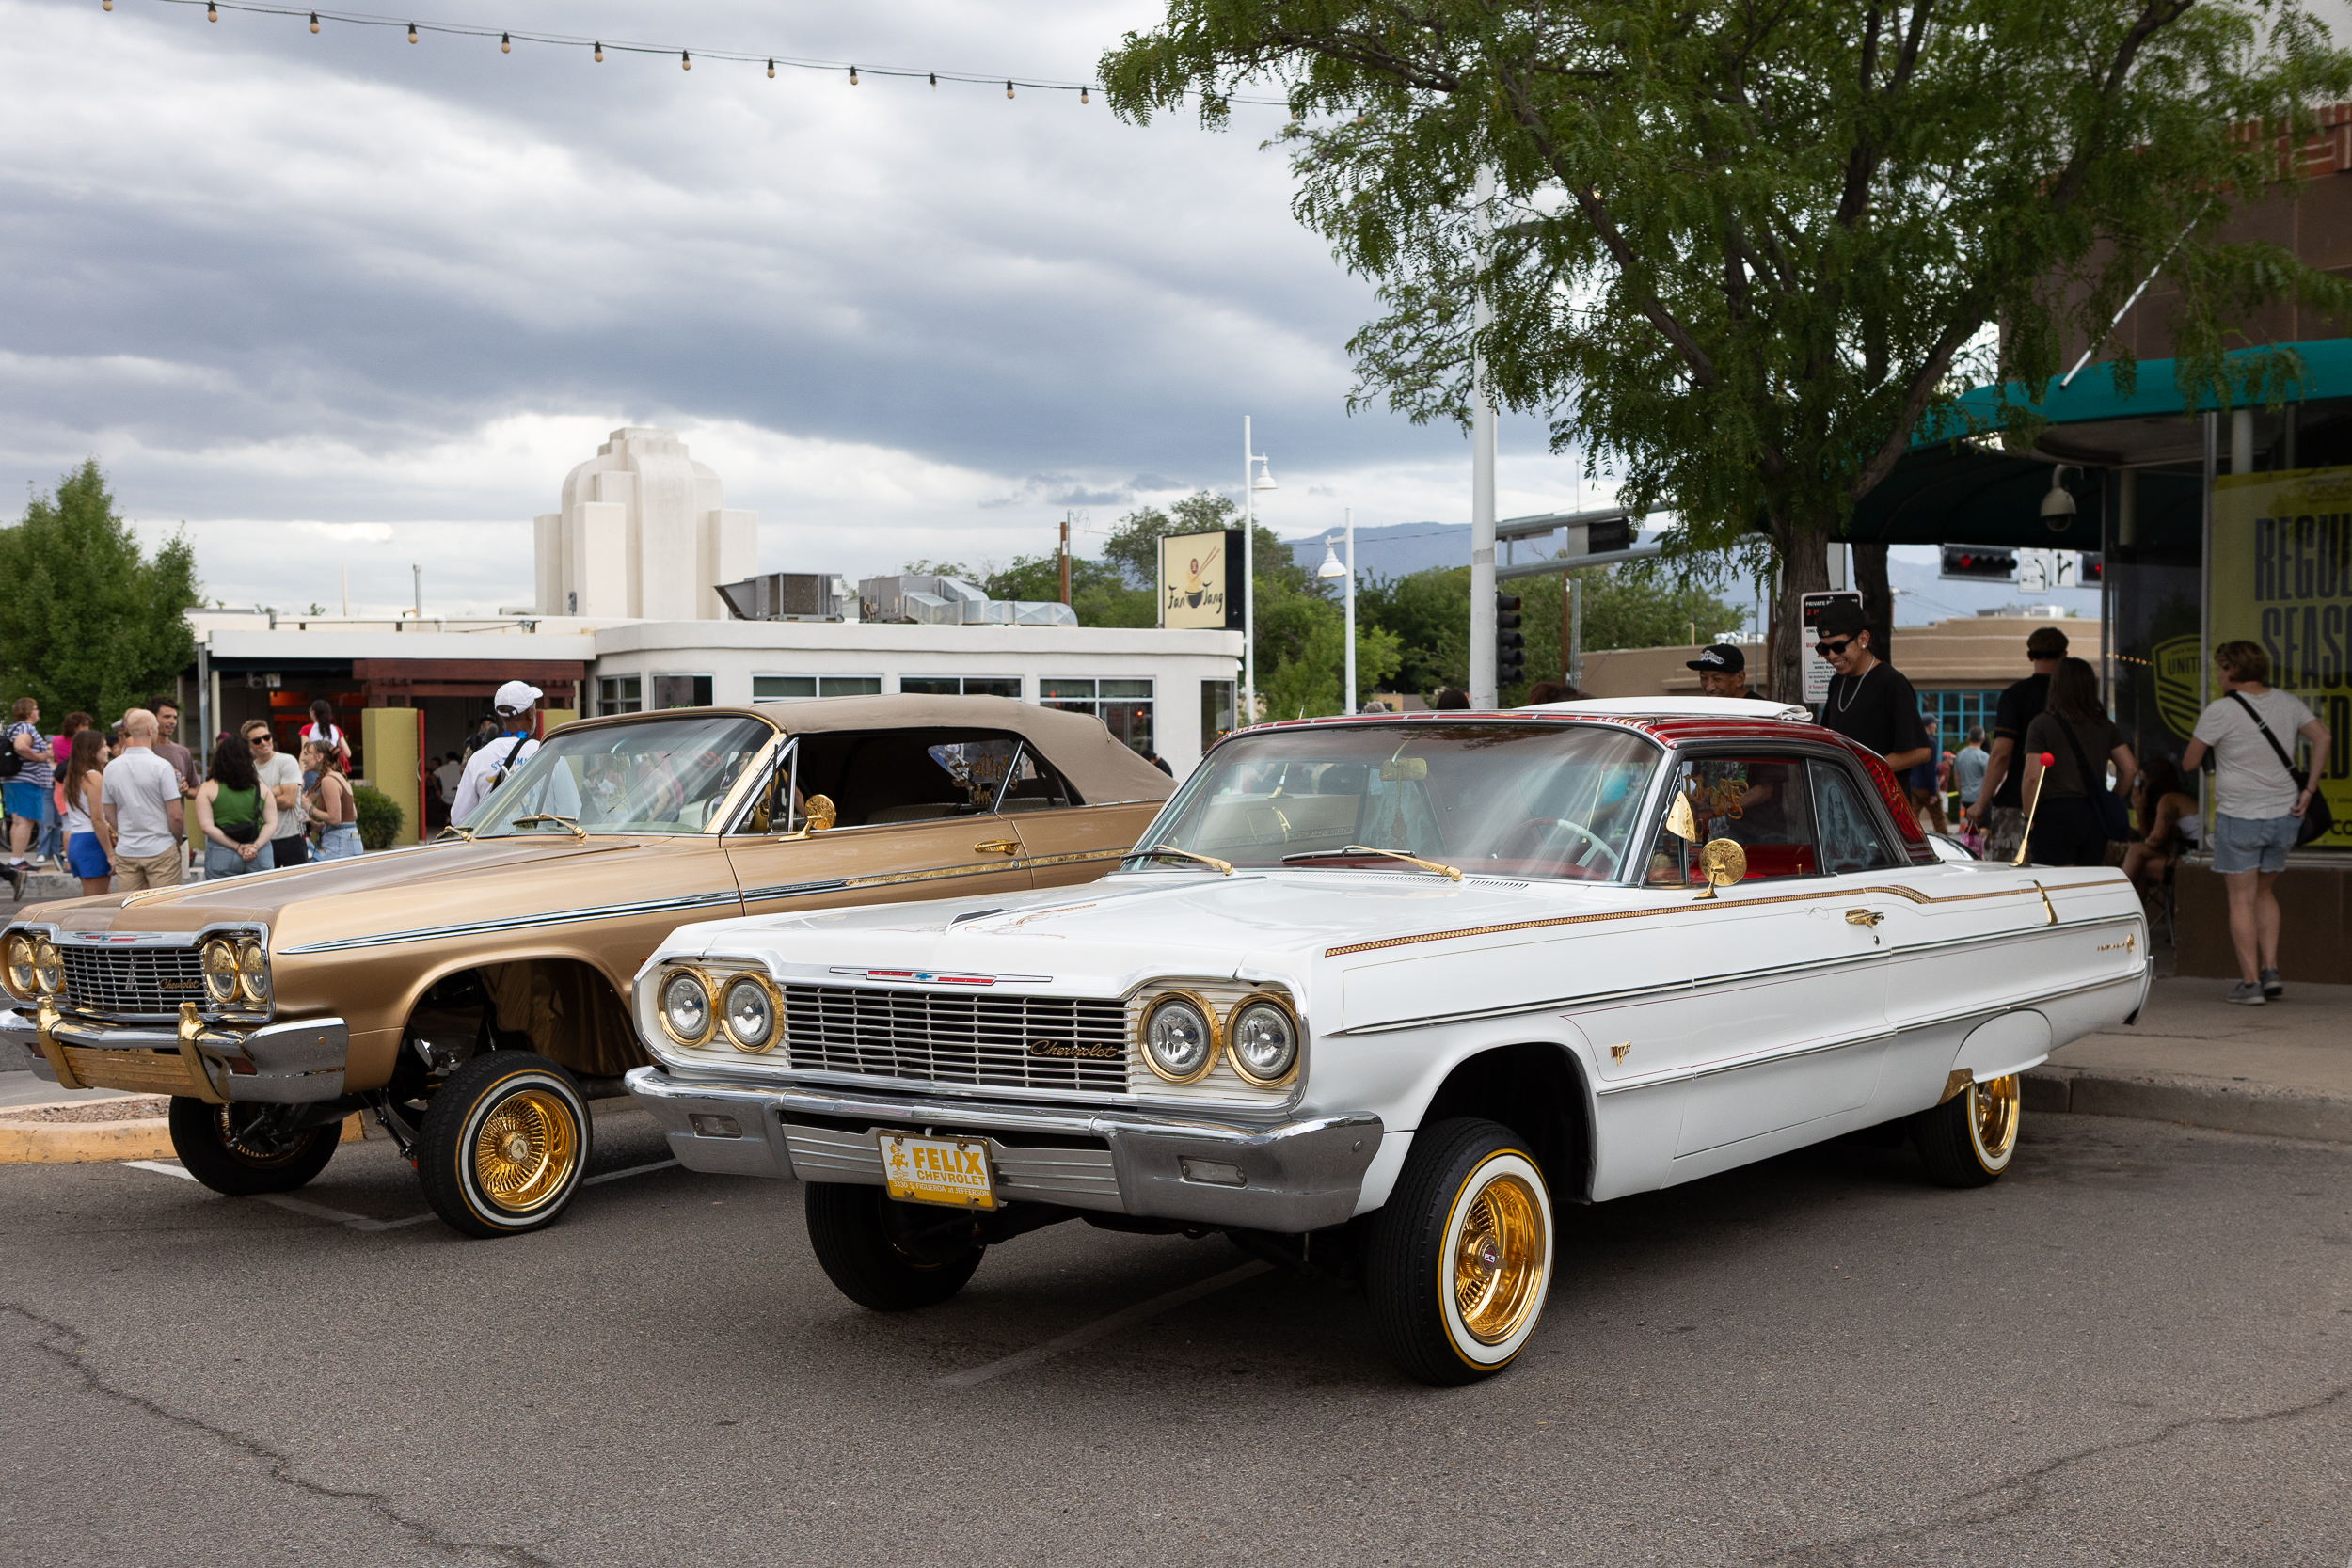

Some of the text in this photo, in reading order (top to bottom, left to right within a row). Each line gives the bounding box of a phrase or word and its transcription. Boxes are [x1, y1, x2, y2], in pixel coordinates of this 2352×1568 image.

[2168, 657, 2201, 674] UNIT
[159, 978, 200, 990] Chevrolet
[1030, 1039, 1118, 1058] Chevrolet
[912, 1147, 985, 1176] FELIX
[916, 1169, 986, 1186] CHEVROLET
[892, 1180, 909, 1189] 3330
[915, 1183, 946, 1193] FIGUEROA
[954, 1187, 990, 1197] JEFFERSON
